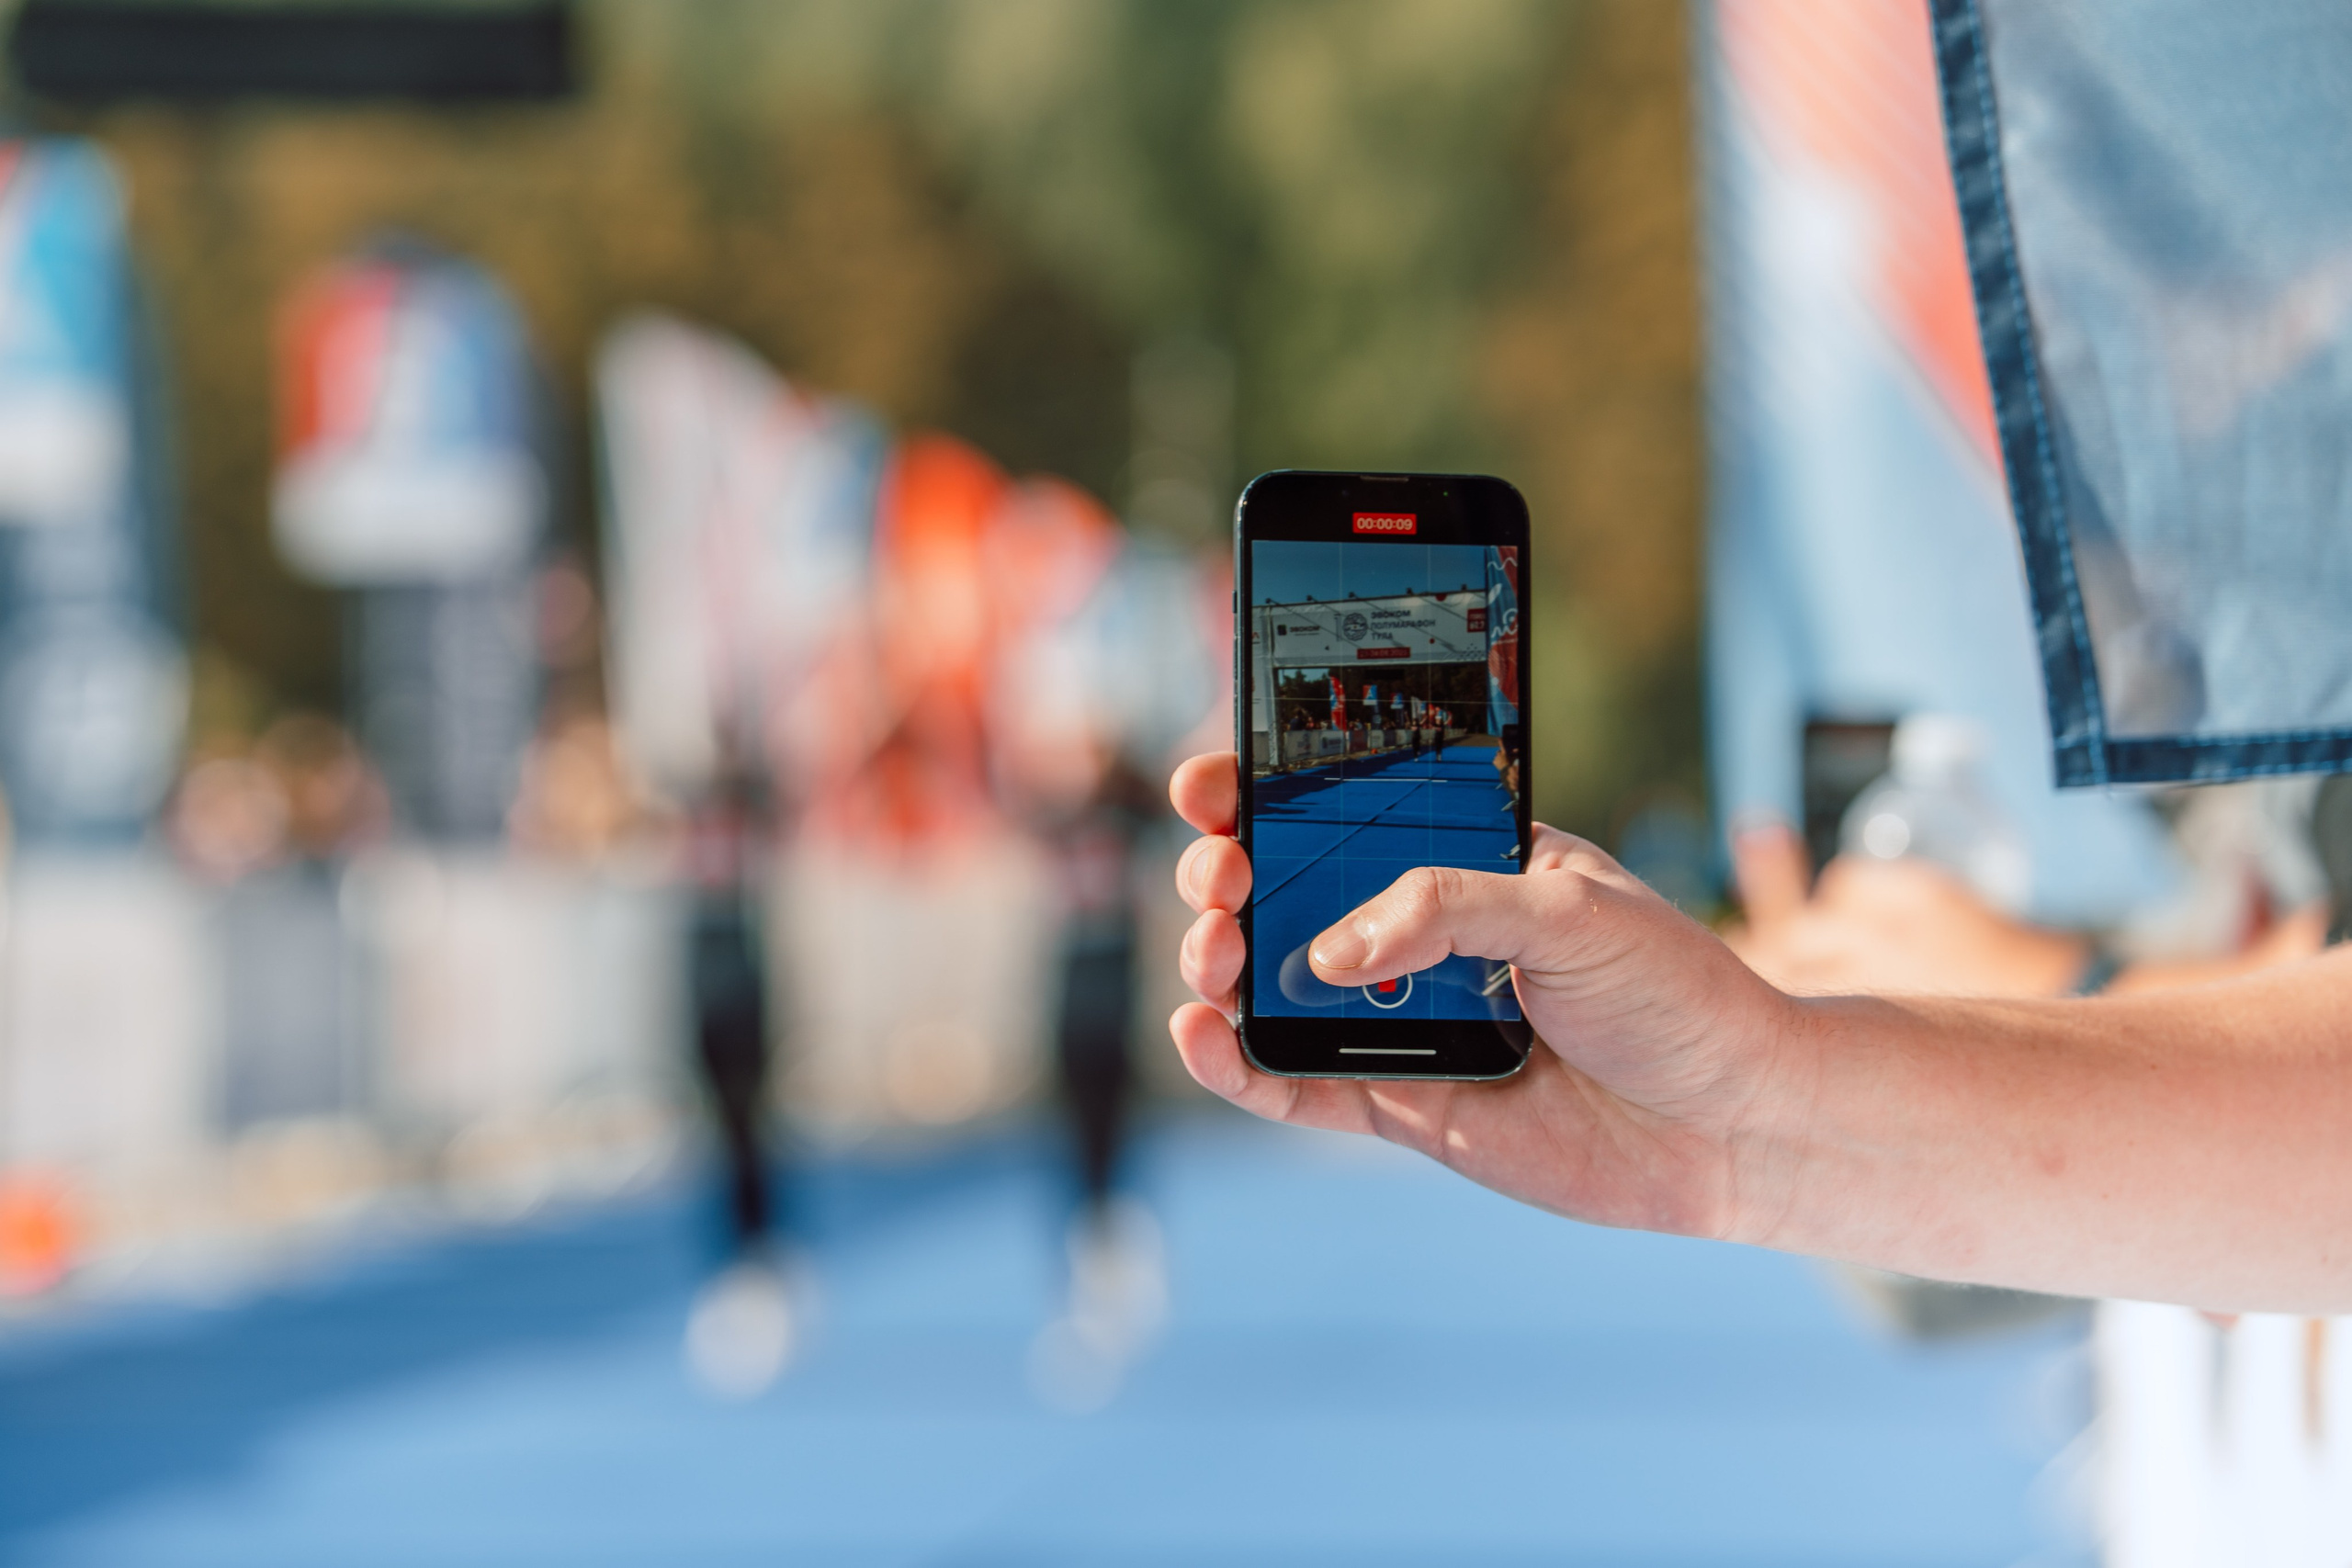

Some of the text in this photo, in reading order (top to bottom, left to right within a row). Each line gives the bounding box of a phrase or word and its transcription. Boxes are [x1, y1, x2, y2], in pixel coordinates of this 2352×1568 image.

[1357, 517, 1413, 531] 00:00:09
[1371, 610, 1411, 619] ЭВОКОМ
[1371, 619, 1436, 629] ПОЛУМАРАФОН
